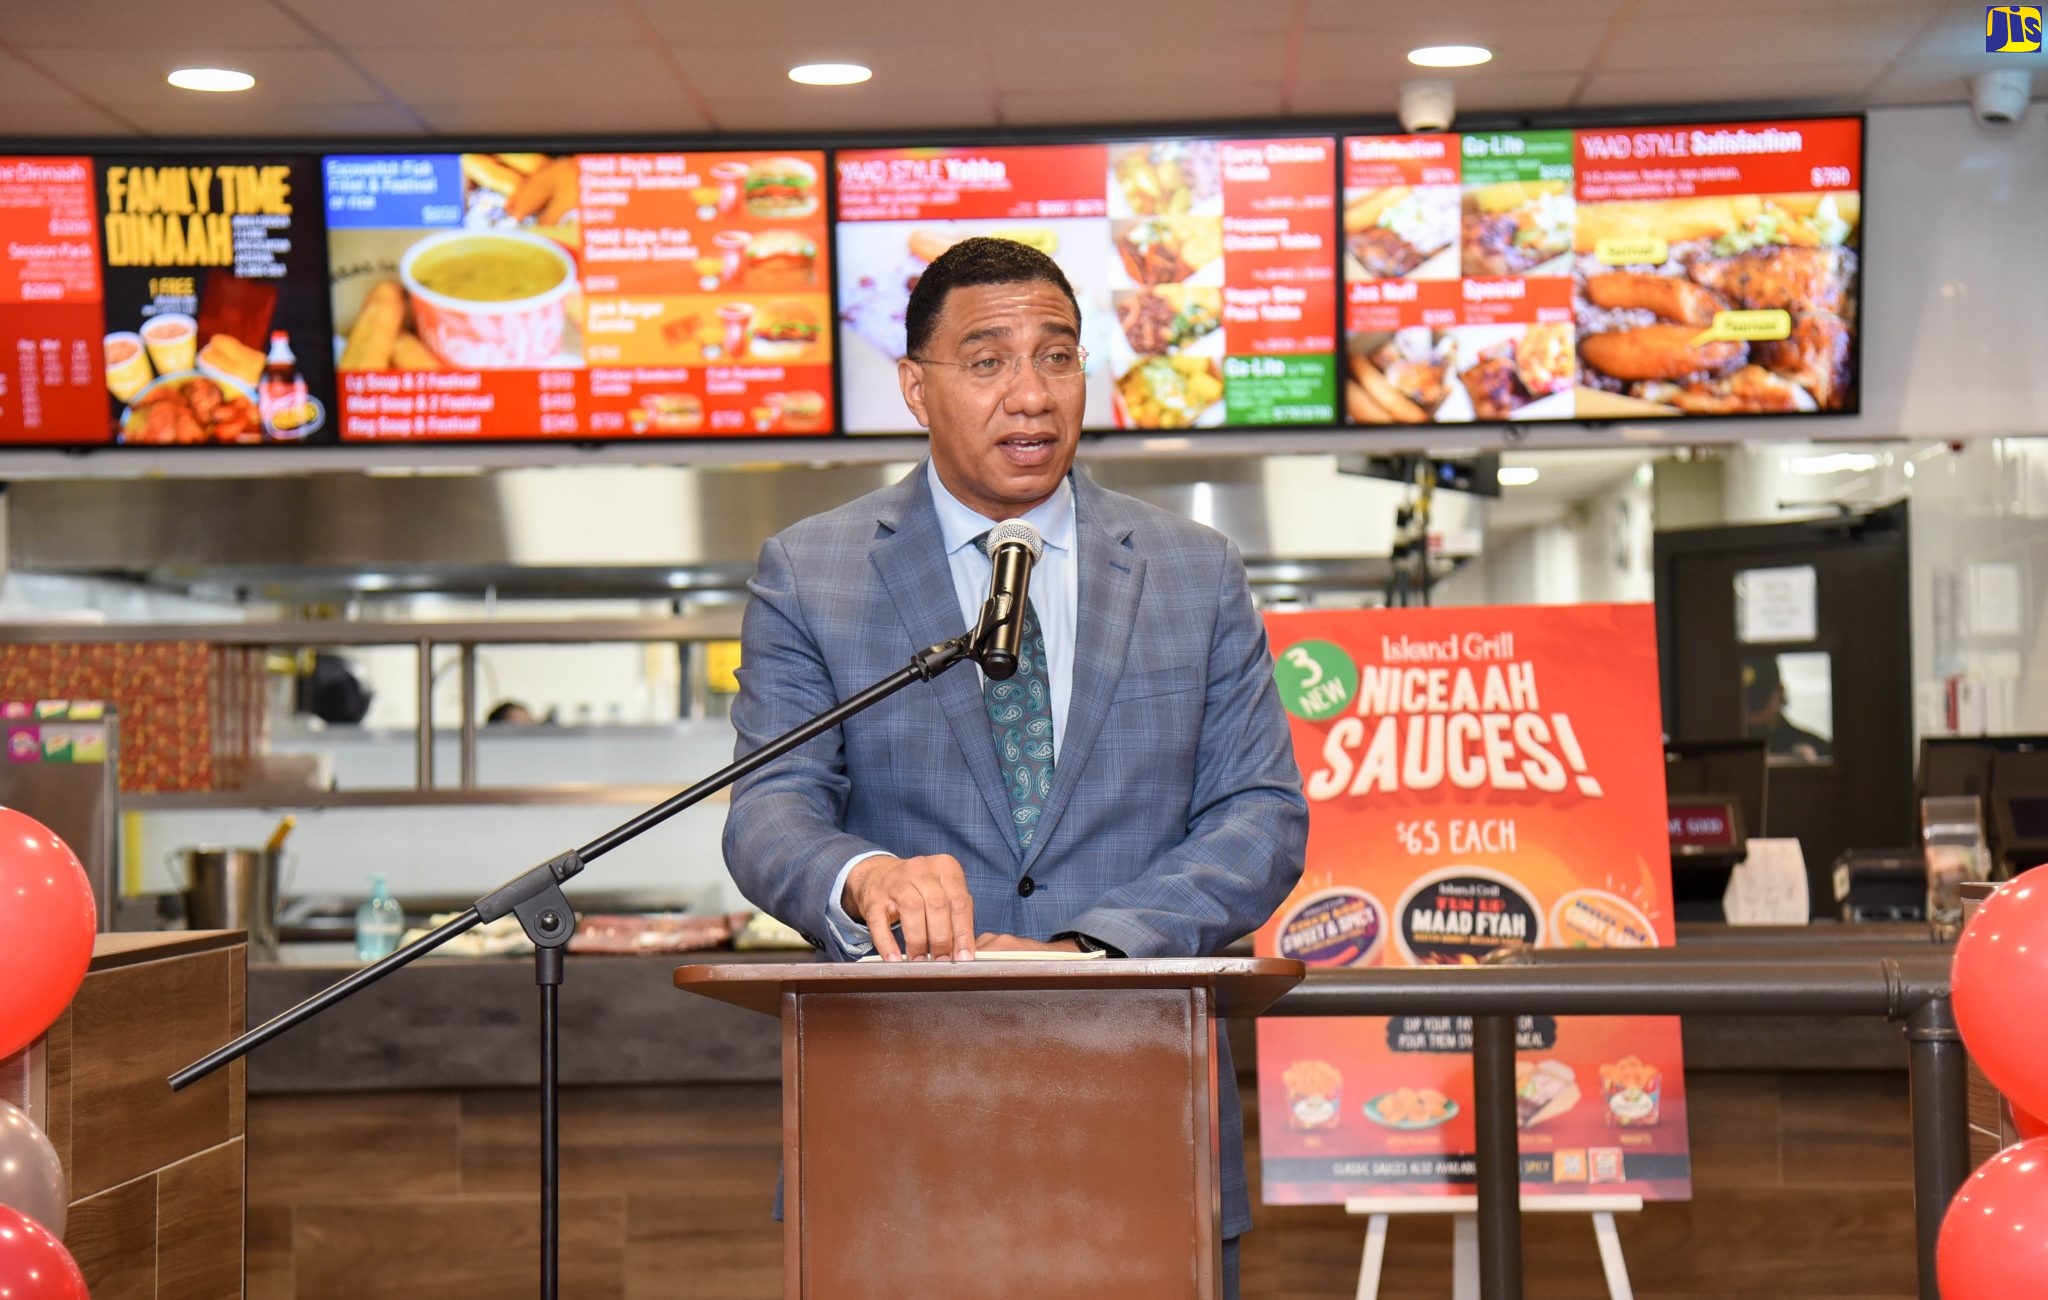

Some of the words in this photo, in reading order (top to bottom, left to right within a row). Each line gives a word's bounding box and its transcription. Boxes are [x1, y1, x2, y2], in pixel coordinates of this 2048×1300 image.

[1582, 134, 1631, 159] YAAD
[1633, 132, 1690, 158] STYLE
[1691, 128, 1802, 156] Satisfaction
[888, 159, 943, 181] STYLE
[107, 166, 213, 213] FAMILY
[216, 165, 293, 214] TIME
[105, 213, 234, 266] DINAAH
[159, 277, 195, 296] FREE
[1462, 278, 1525, 303] Special
[619, 301, 665, 319] Burger
[427, 371, 481, 391] Festival
[440, 392, 494, 412] Festival
[427, 414, 481, 435] Festival
[1382, 634, 1459, 663] Island
[1463, 632, 1514, 661] Grill
[1285, 646, 1323, 688] 3
[1298, 676, 1347, 717] NEW
[1356, 661, 1539, 716] NICEAAH
[1307, 713, 1604, 801] SAUCES!
[1396, 820, 1440, 856] $65
[1449, 819, 1517, 855] EACH
[1326, 920, 1338, 939] &
[1338, 906, 1375, 934] SPICY
[1412, 908, 1473, 934] MAAD
[1475, 910, 1526, 938] FYAH
